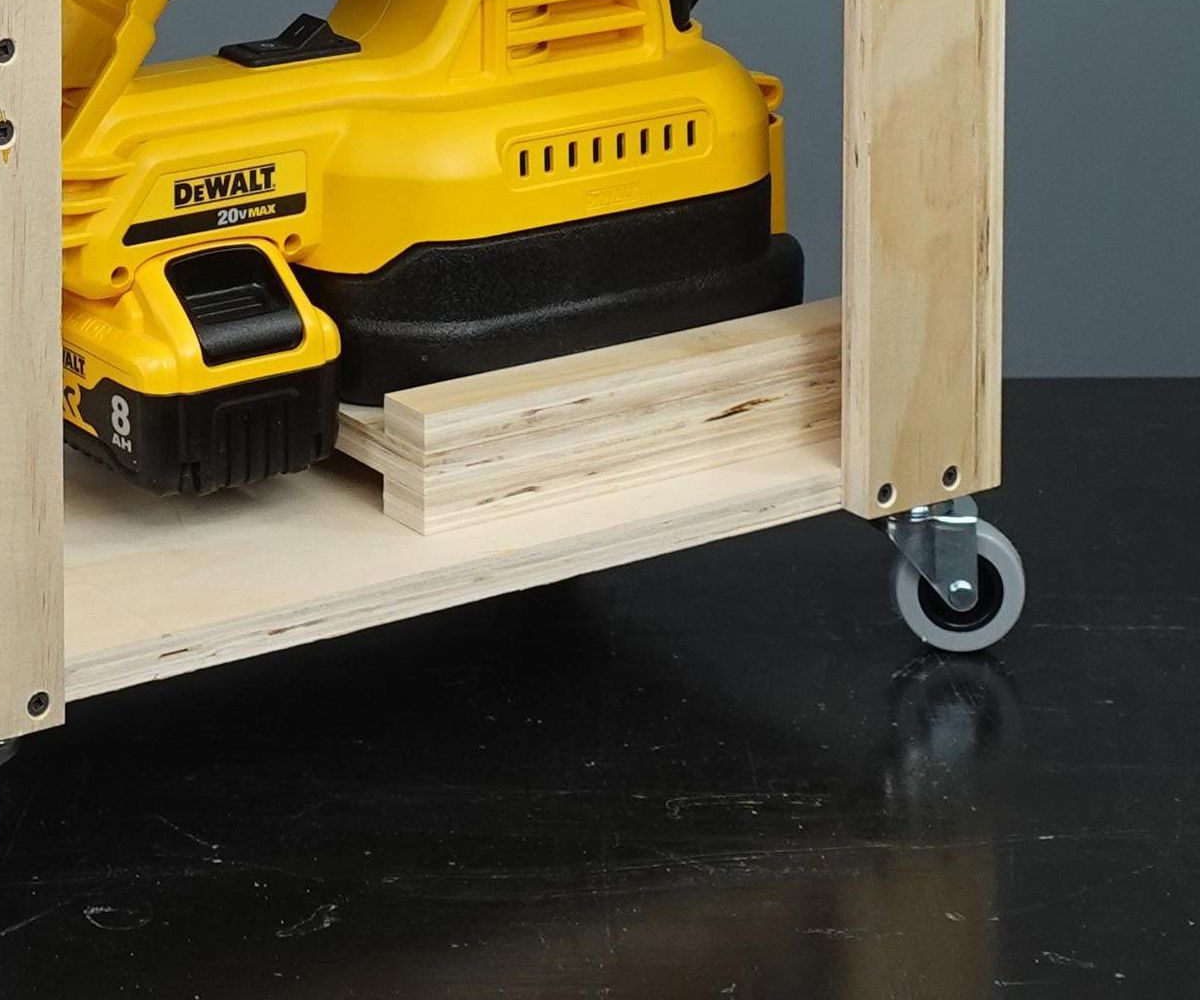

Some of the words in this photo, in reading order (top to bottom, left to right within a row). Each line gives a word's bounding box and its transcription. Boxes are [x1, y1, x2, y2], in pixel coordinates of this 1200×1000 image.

[248, 203, 276, 218] MAX
[63, 348, 86, 376] ALT
[111, 394, 131, 437] 8
[111, 433, 133, 454] AH
